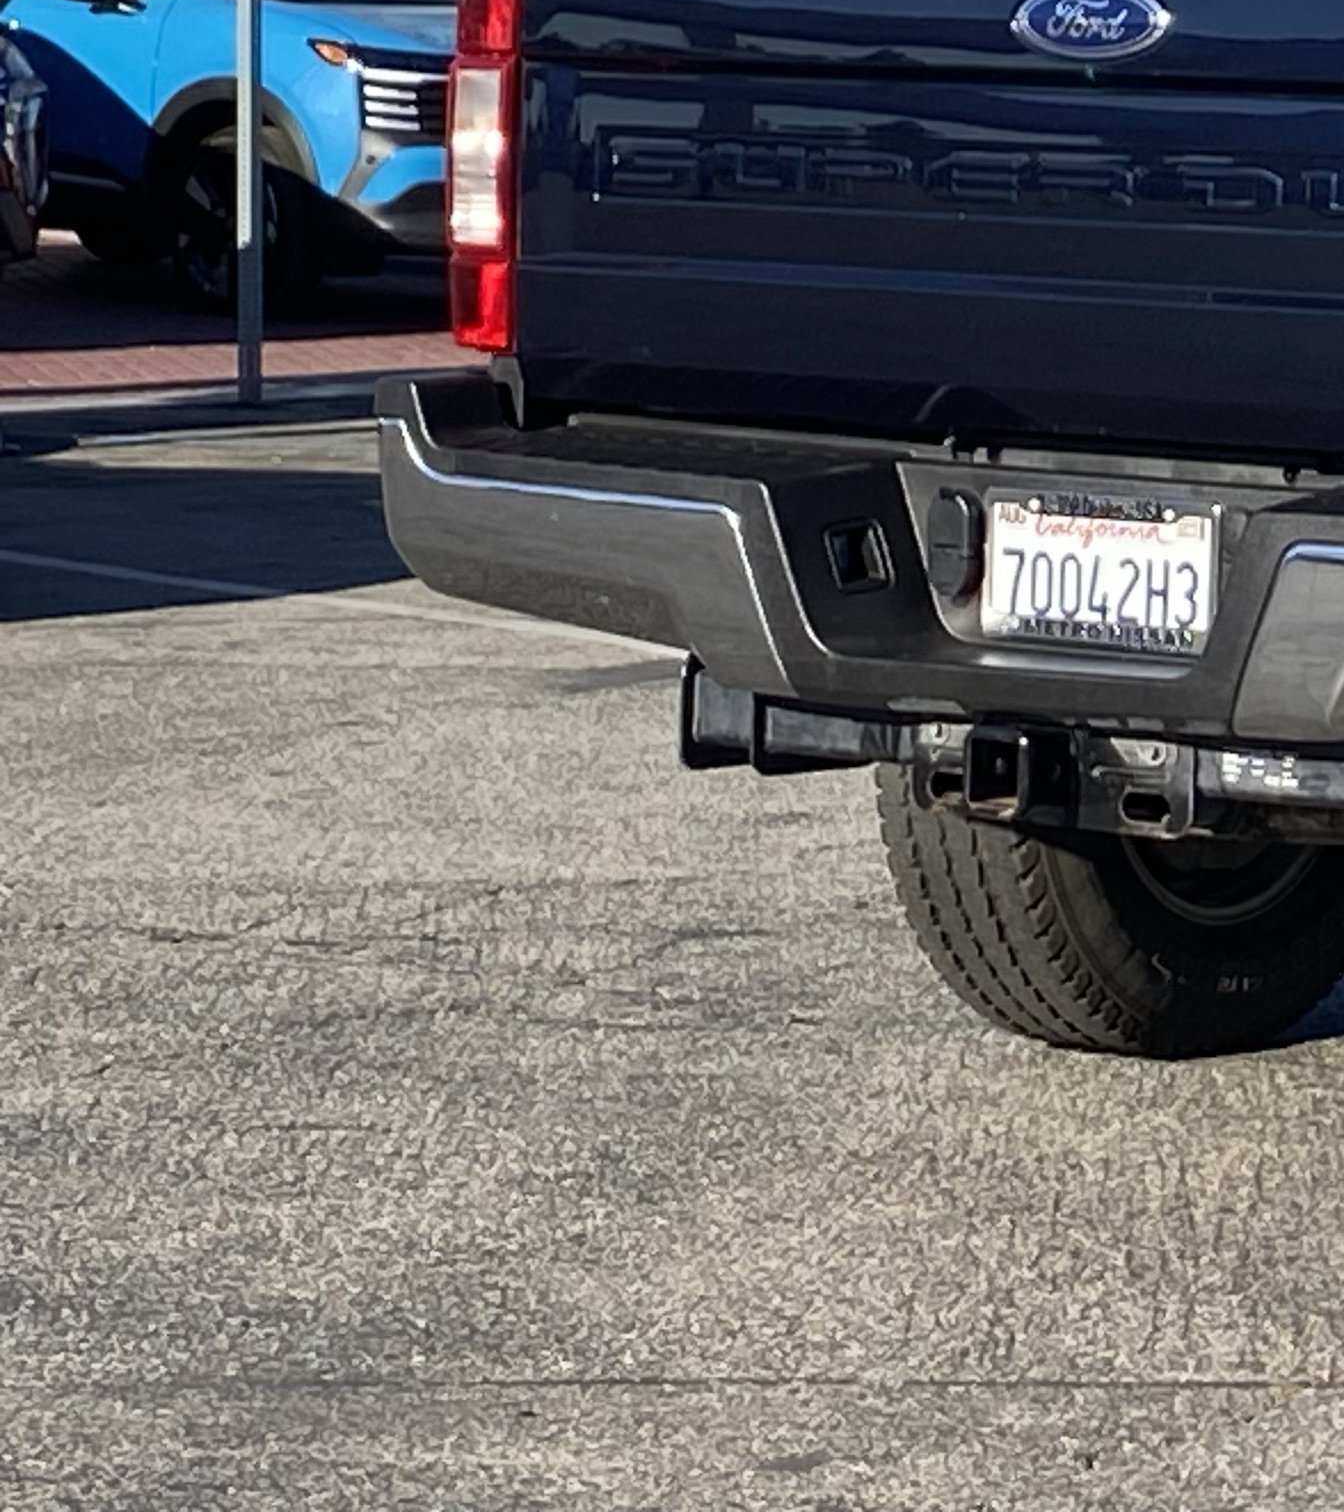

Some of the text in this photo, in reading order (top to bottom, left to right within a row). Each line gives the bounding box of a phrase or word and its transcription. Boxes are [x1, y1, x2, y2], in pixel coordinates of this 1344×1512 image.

[606, 133, 1144, 208] SUPER
[1033, 513, 1166, 550] California
[1002, 546, 1200, 631] 70042H3
